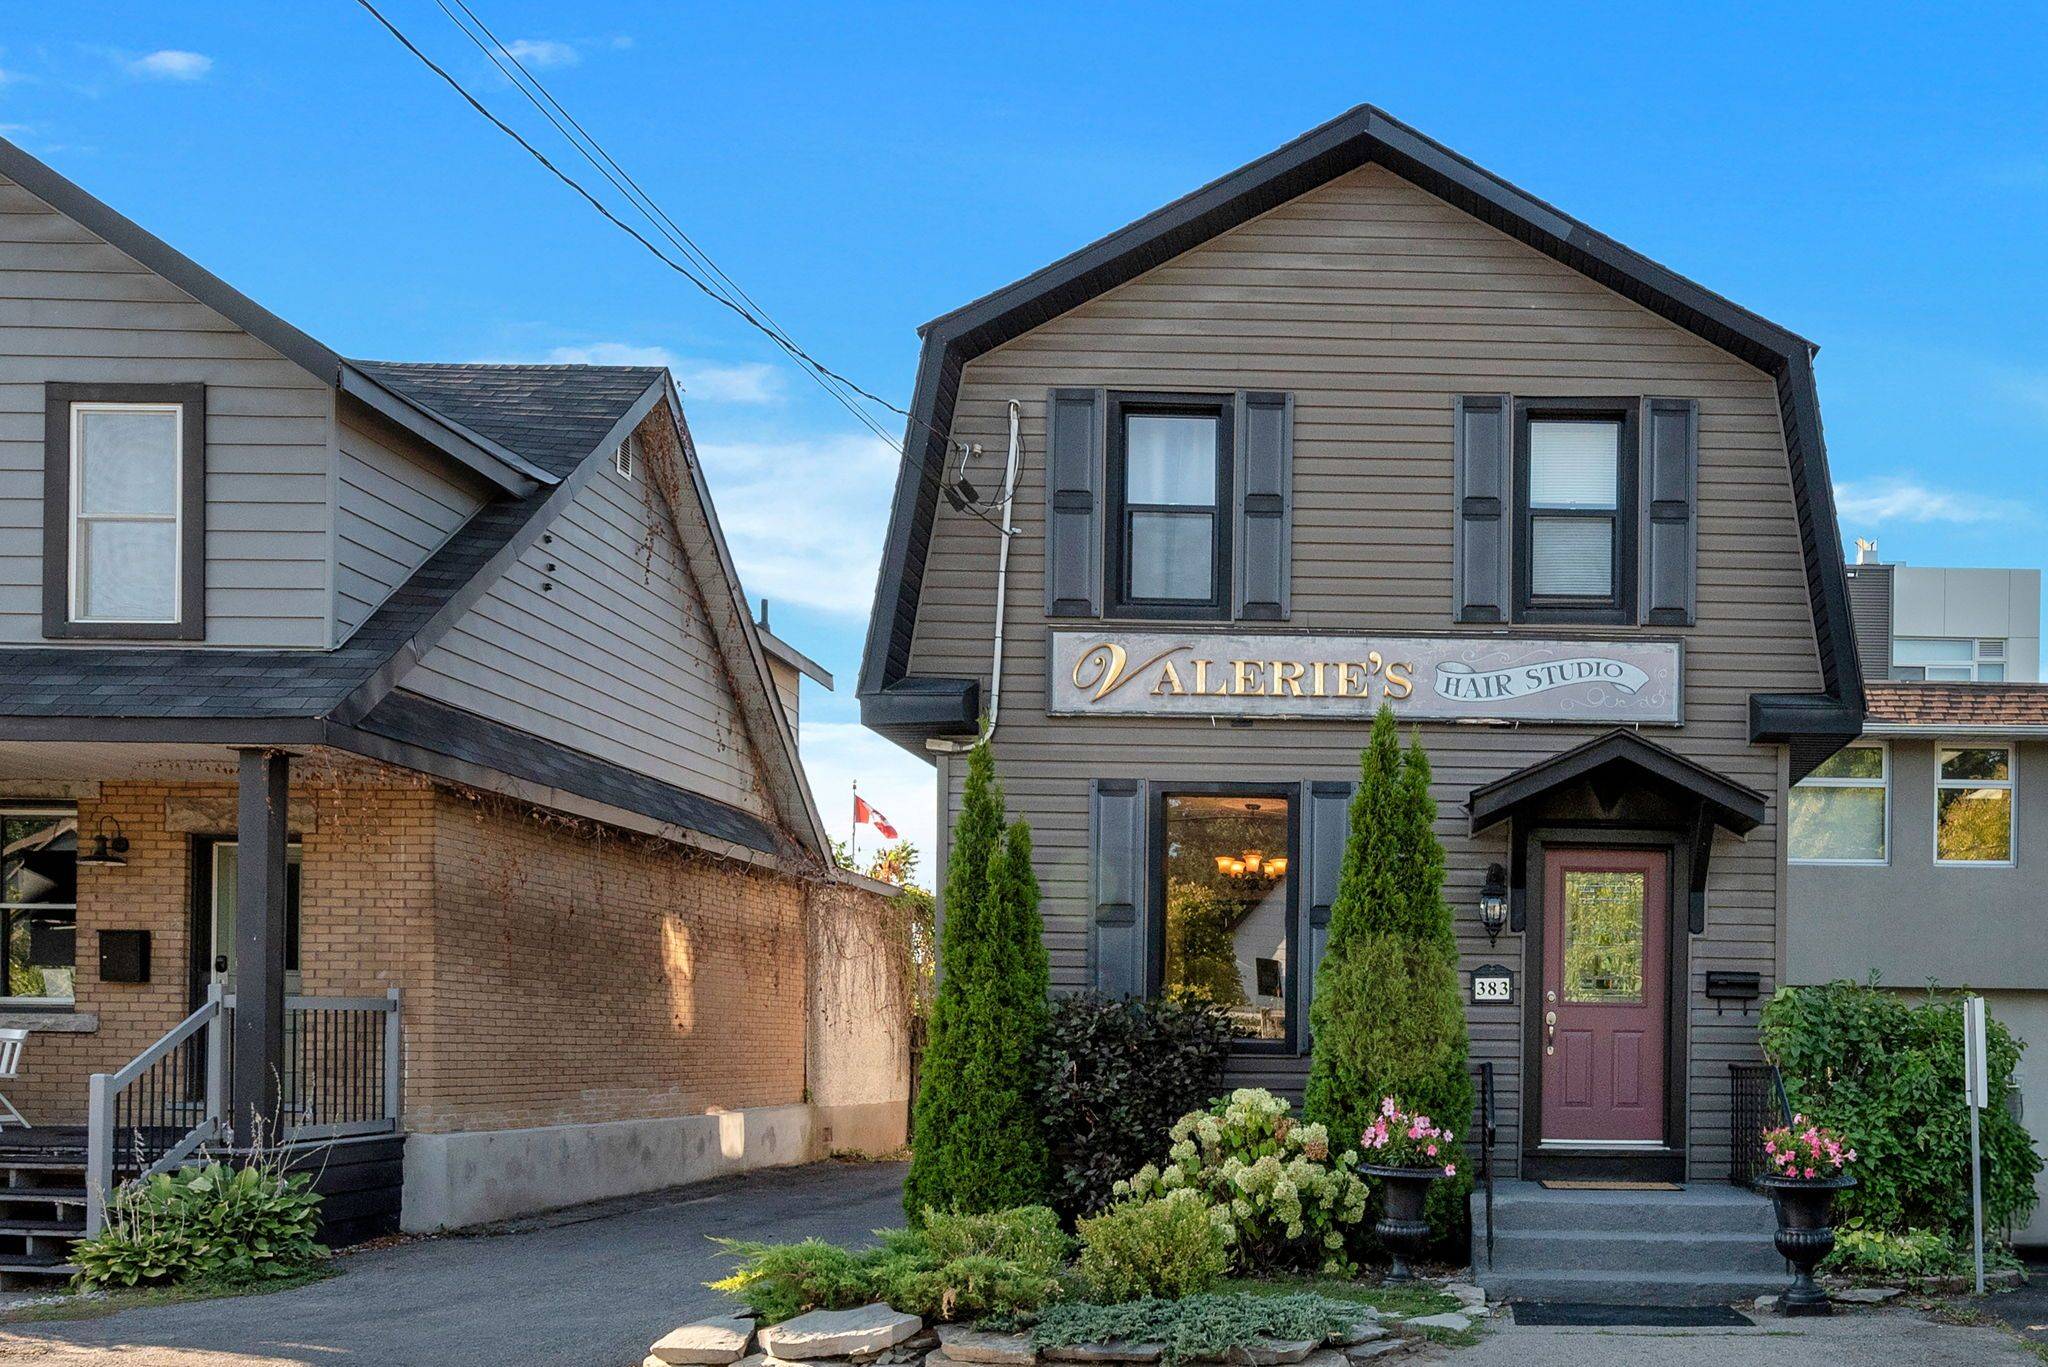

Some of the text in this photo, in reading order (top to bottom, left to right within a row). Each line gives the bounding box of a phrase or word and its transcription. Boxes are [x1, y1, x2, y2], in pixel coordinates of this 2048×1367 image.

[1073, 643, 1413, 701] VALERIE'S
[1443, 661, 1623, 699] HAIR STUDIO
[1477, 981, 1508, 996] 383
